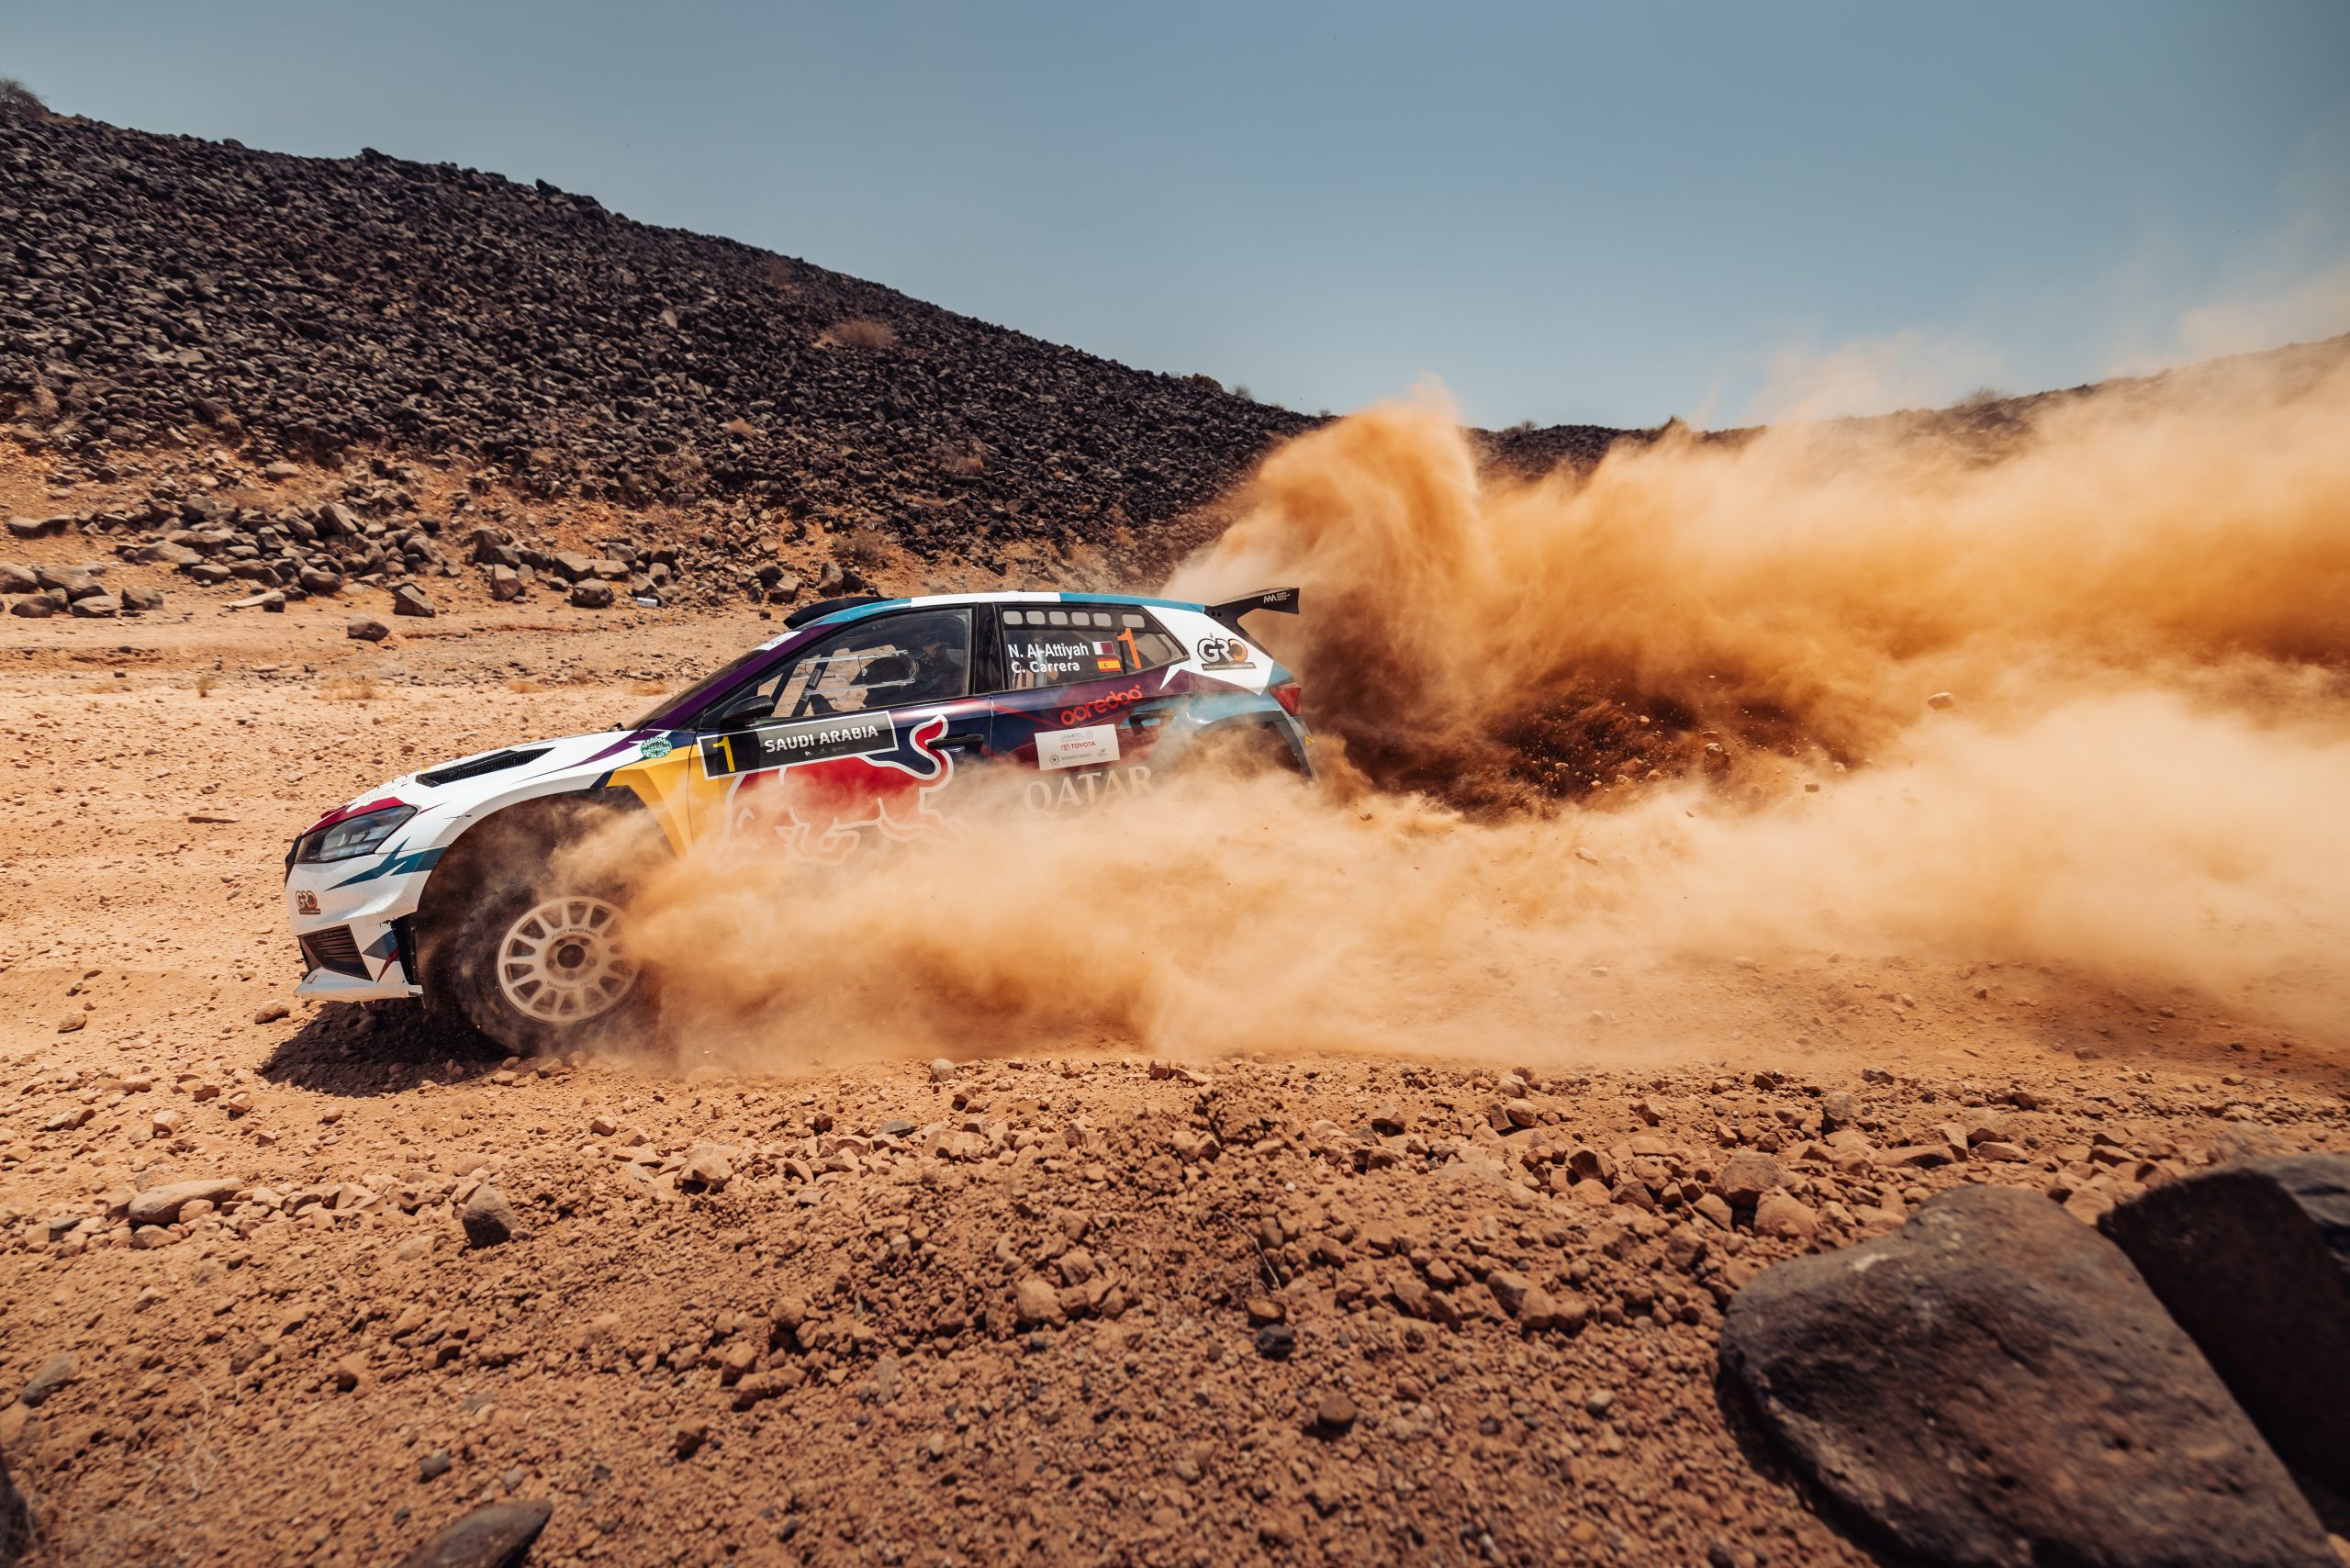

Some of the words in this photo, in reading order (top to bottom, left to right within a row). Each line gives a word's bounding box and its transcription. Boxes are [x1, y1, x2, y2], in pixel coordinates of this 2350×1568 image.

[1007, 644, 1024, 658] N.
[1027, 642, 1090, 660] Al-Attiyah
[1116, 627, 1142, 669] 1
[1197, 638, 1248, 663] GRO
[1011, 661, 1026, 673] C.
[1030, 660, 1080, 673] Carrera
[1060, 684, 1143, 726] ooredoo
[764, 734, 815, 753] SAUDI
[819, 724, 879, 745] ARABIA
[1070, 741, 1096, 749] TOYOTA
[712, 735, 735, 772] 1
[1024, 766, 1154, 814] QATAR
